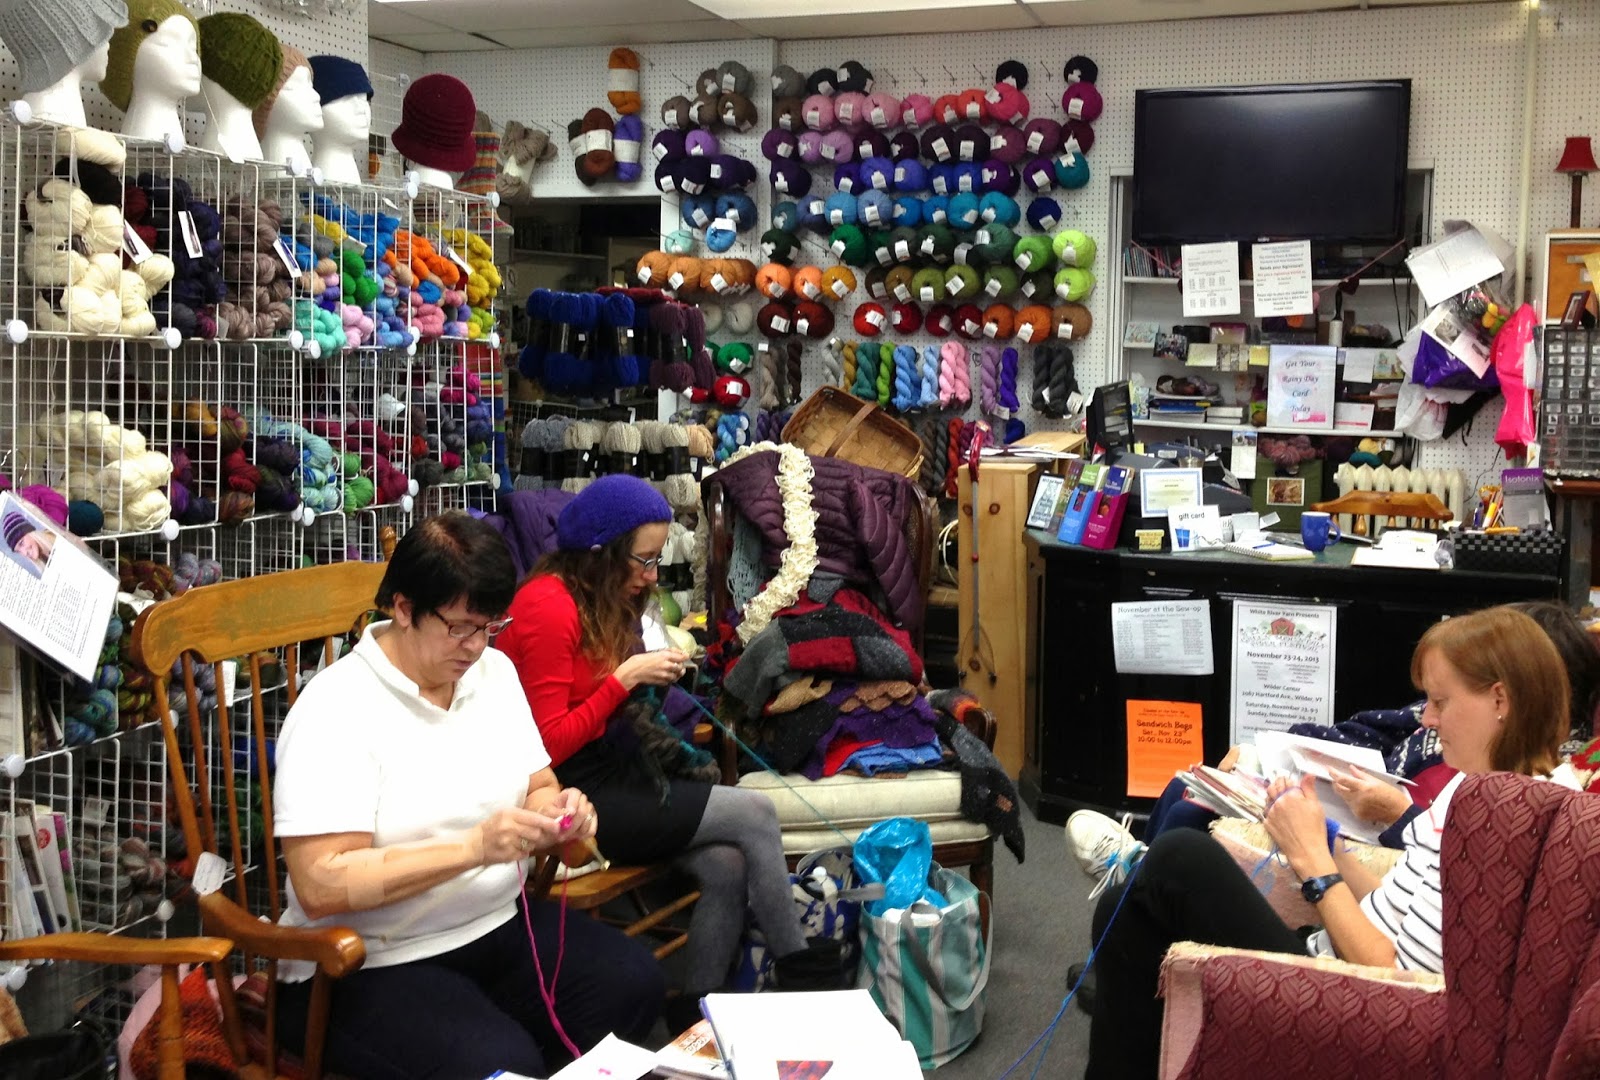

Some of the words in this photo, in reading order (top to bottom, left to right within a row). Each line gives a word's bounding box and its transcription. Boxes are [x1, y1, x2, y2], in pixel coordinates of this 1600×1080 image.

[1285, 361, 1297, 369] Get
[1282, 375, 1302, 384] Rainy
[1303, 375, 1319, 384] Day
[1292, 389, 1309, 397] Card
[1290, 404, 1311, 413] Today
[1505, 475, 1540, 483] Isotonix
[1179, 513, 1189, 521] gift
[1162, 605, 1174, 613] the
[1247, 651, 1282, 659] November
[1271, 703, 1300, 711] November
[1269, 711, 1298, 719] November
[1136, 719, 1173, 728] Sandwich
